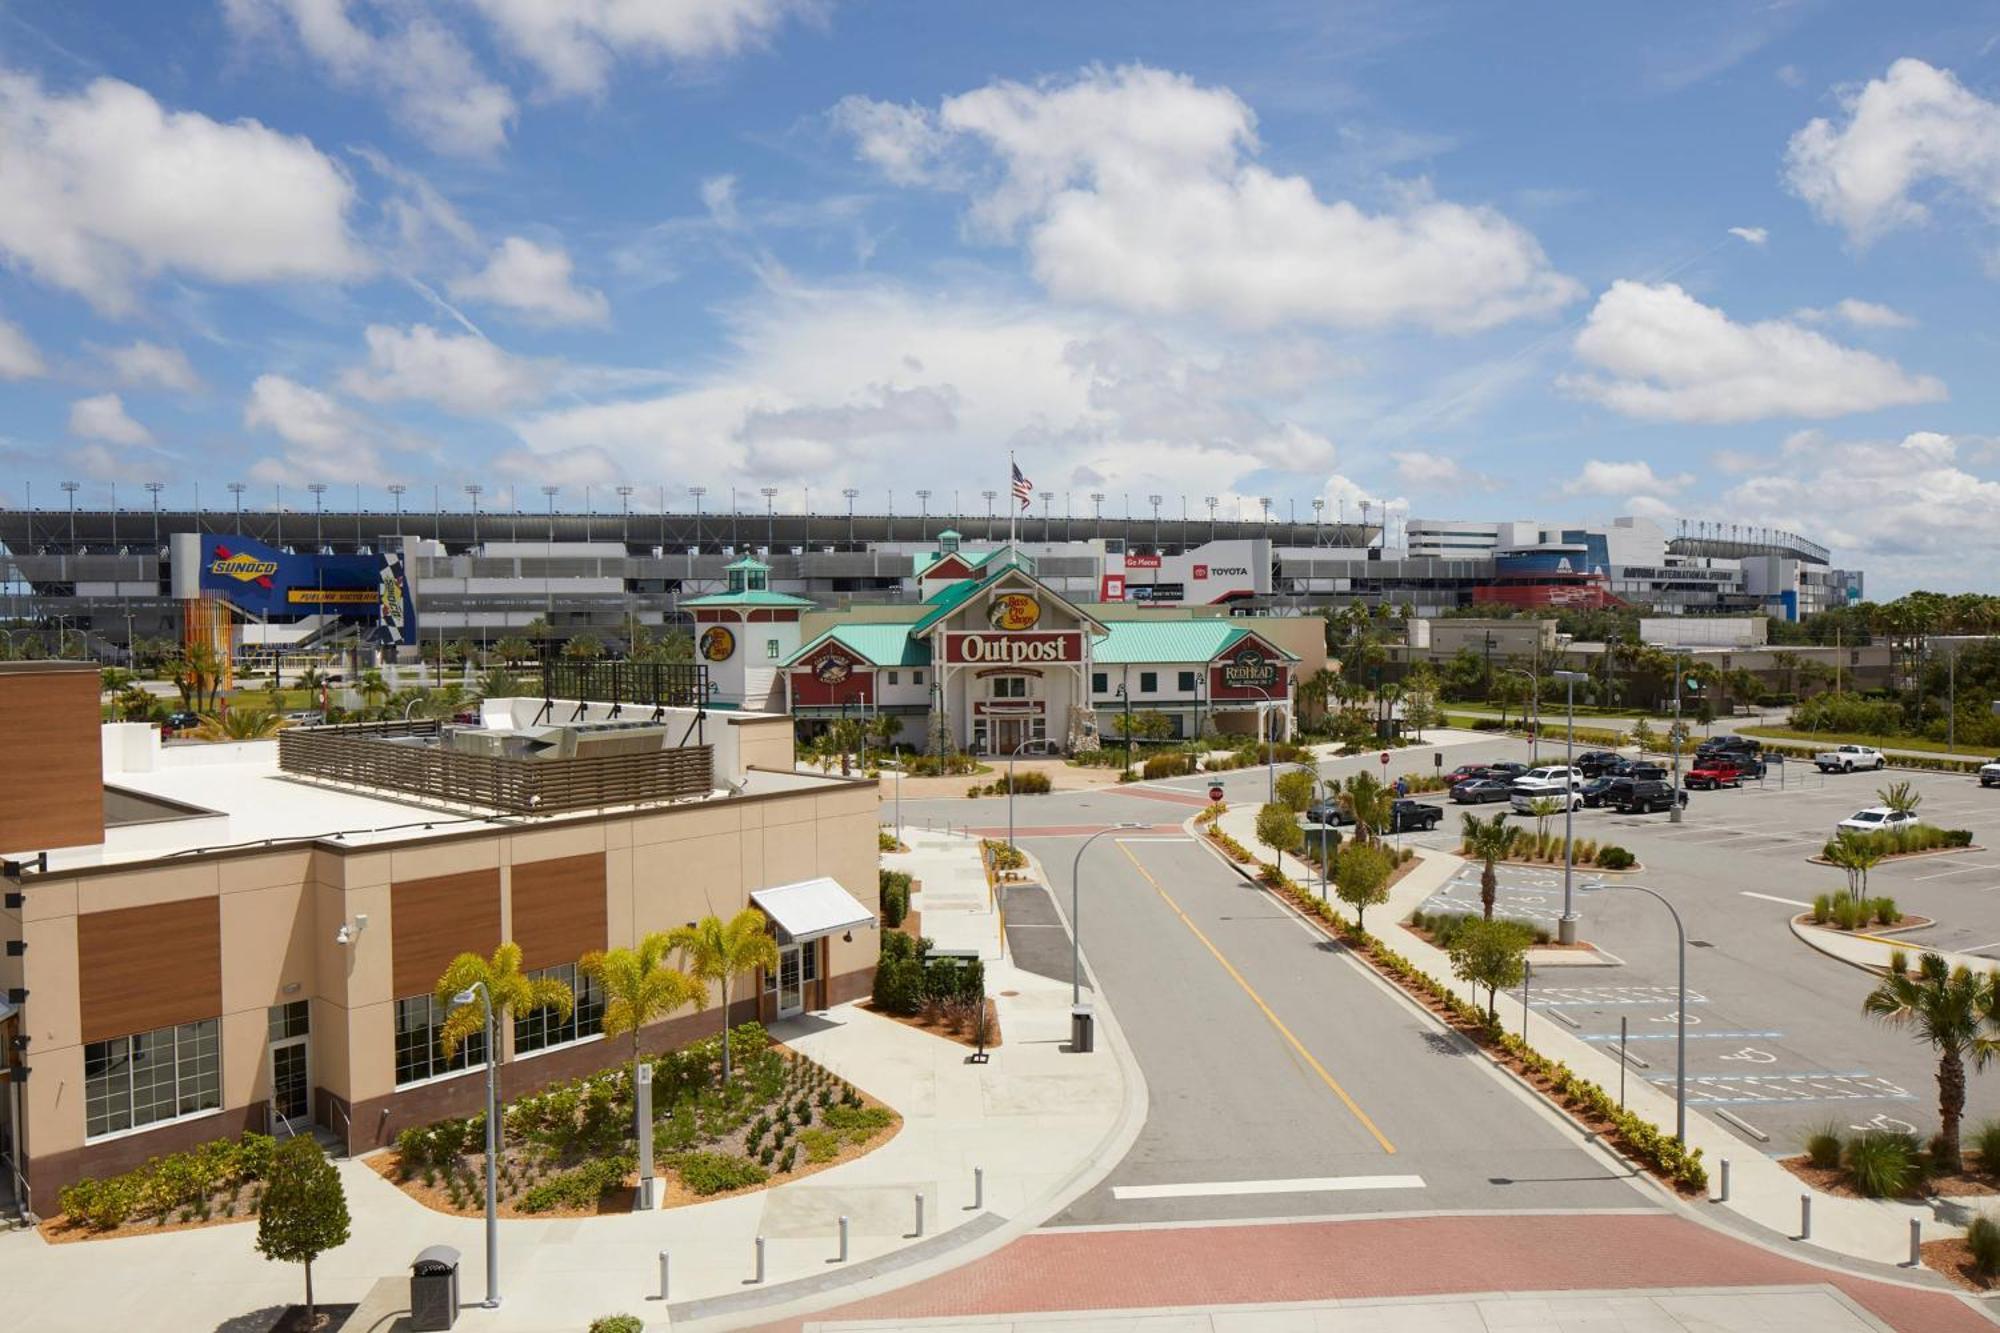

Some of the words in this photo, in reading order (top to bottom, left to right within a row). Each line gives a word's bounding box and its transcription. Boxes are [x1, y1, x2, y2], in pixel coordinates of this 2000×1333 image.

[215, 562, 275, 573] SUNOCO
[1211, 567, 1248, 576] TOYOTA
[1008, 596, 1029, 607] Bass
[1009, 606, 1024, 615] Pro
[1010, 616, 1034, 626] Shops
[961, 635, 1067, 666] Outpost
